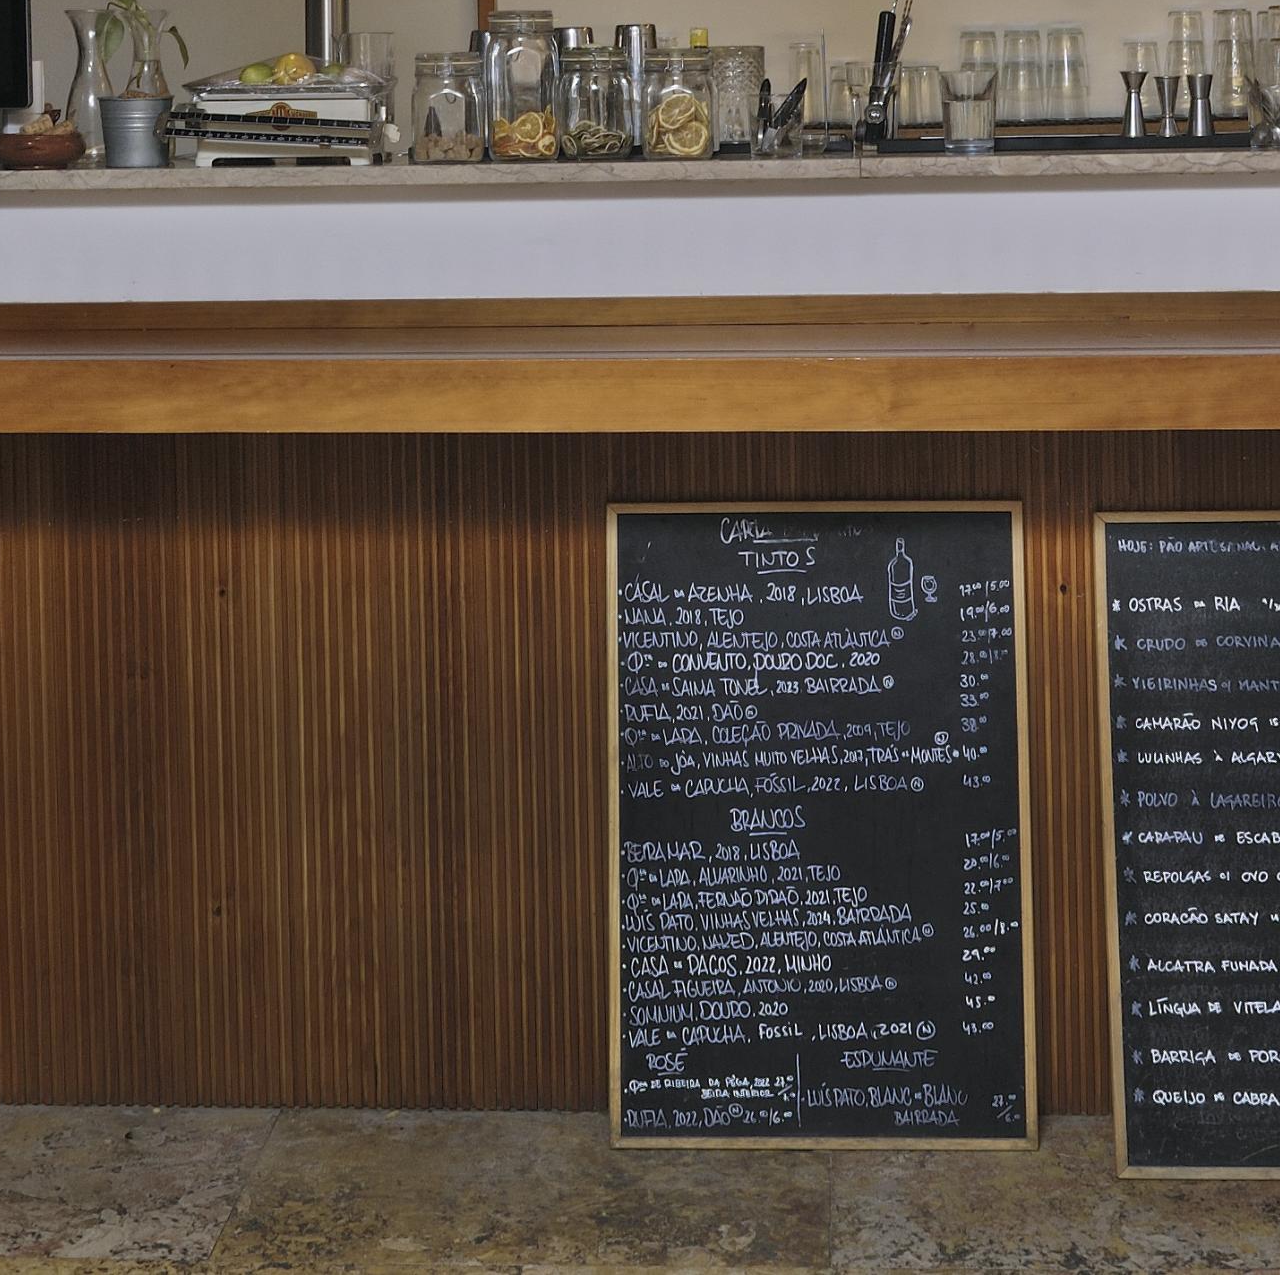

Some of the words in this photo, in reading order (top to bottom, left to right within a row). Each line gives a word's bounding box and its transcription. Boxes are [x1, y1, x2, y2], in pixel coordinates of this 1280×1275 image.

[1159, 537, 1182, 553] PÃO
[1129, 597, 1182, 612] OSTRAS
[1215, 596, 1240, 612] RIA
[709, 608, 743, 629] TEJO
[1137, 638, 1185, 651] CRUDO
[850, 652, 880, 667] 2020
[1136, 713, 1200, 730] CAMARÃO
[628, 780, 663, 798] VALE
[855, 775, 907, 791] LISBOA
[1138, 791, 1177, 807] POLVO
[730, 805, 805, 831] BRANCOS
[751, 839, 800, 861] LISBOA
[807, 865, 840, 881] TEJO
[1242, 871, 1268, 882] OVO
[833, 887, 867, 906] TEJO
[1215, 912, 1258, 925] SATAY
[785, 954, 831, 973] MINHO
[1148, 959, 1215, 972] ALCATRA
[1221, 960, 1278, 972] FUMADA
[758, 1001, 788, 1016] 2020
[629, 1029, 661, 1048] VALE
[1151, 1049, 1216, 1066] BARRIGA
[1153, 1090, 1205, 1105] QUEIJO
[1233, 1092, 1280, 1106] CABRA
